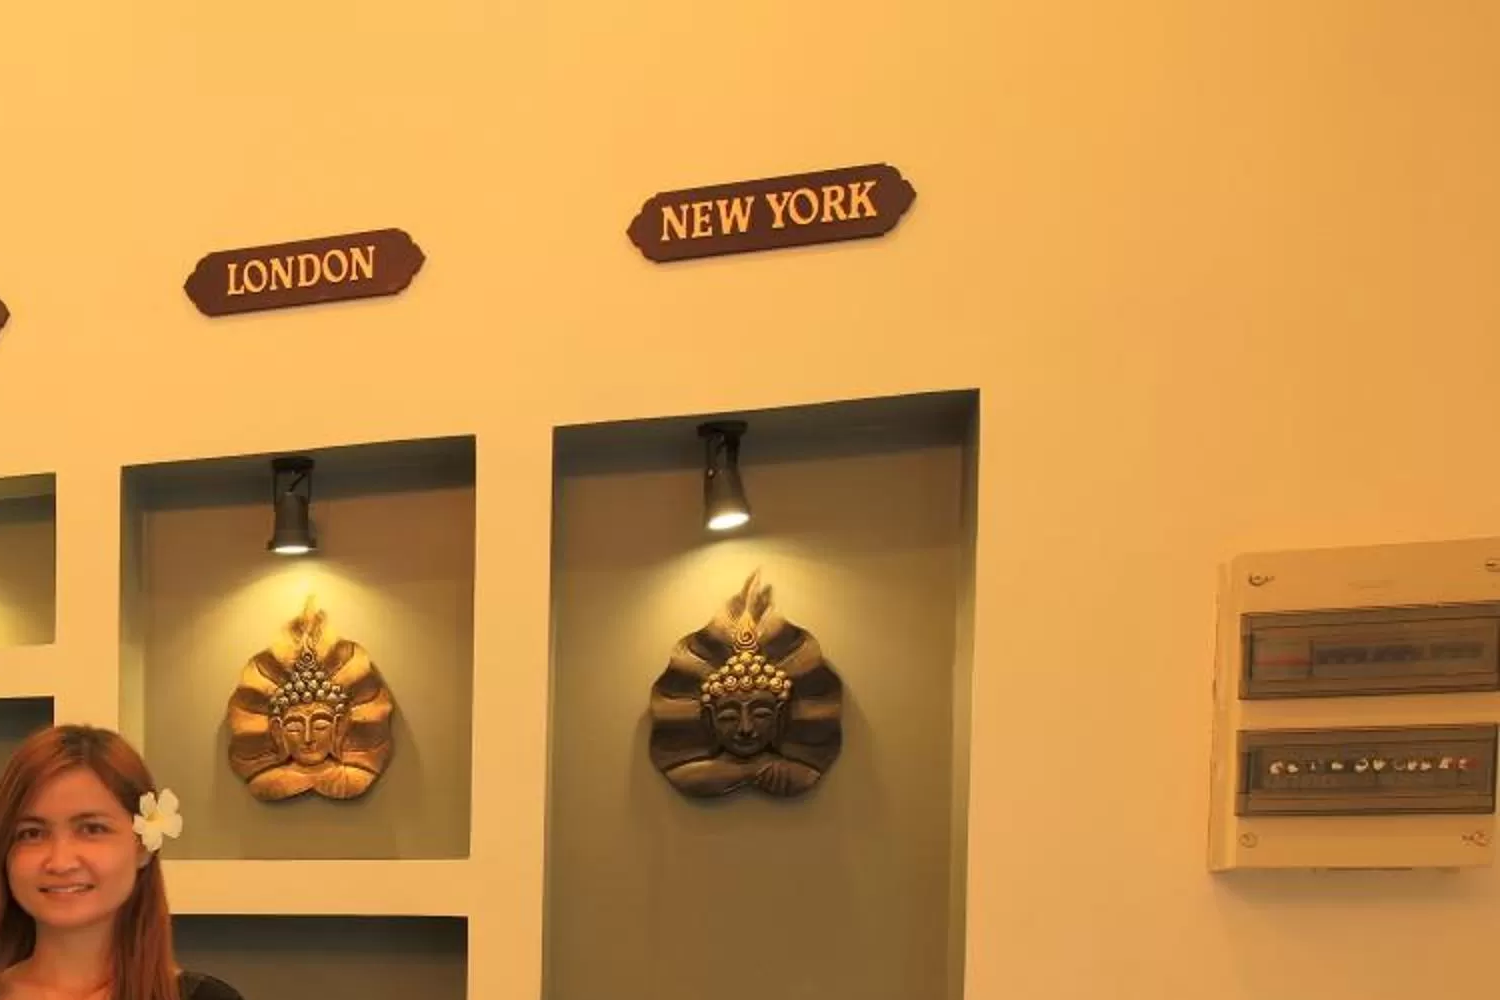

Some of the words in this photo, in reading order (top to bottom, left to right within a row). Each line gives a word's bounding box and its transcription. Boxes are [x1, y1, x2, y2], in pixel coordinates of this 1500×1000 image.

[659, 191, 752, 242] NEW
[766, 180, 879, 229] YORK
[226, 246, 375, 296] LONDON
